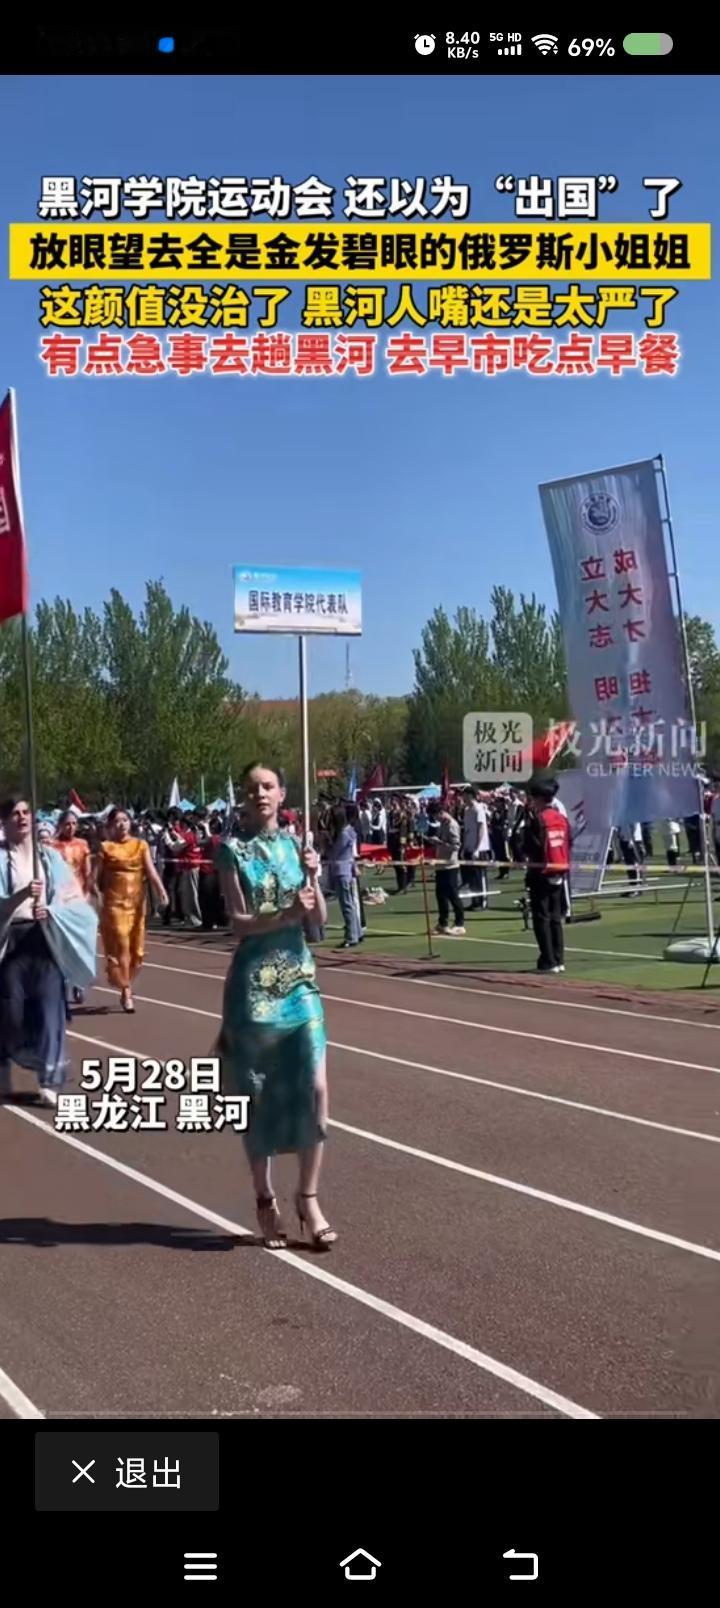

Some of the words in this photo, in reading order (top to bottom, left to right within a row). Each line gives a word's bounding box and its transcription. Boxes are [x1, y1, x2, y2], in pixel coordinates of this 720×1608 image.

[445, 31, 481, 45] 8.40
[489, 32, 504, 42] 5G
[507, 32, 522, 42] HD
[446, 46, 480, 60] KB/s
[567, 38, 616, 58] 69%
[248, 589, 349, 614] 国际教育学院代表队
[115, 1456, 182, 1489] 退出
